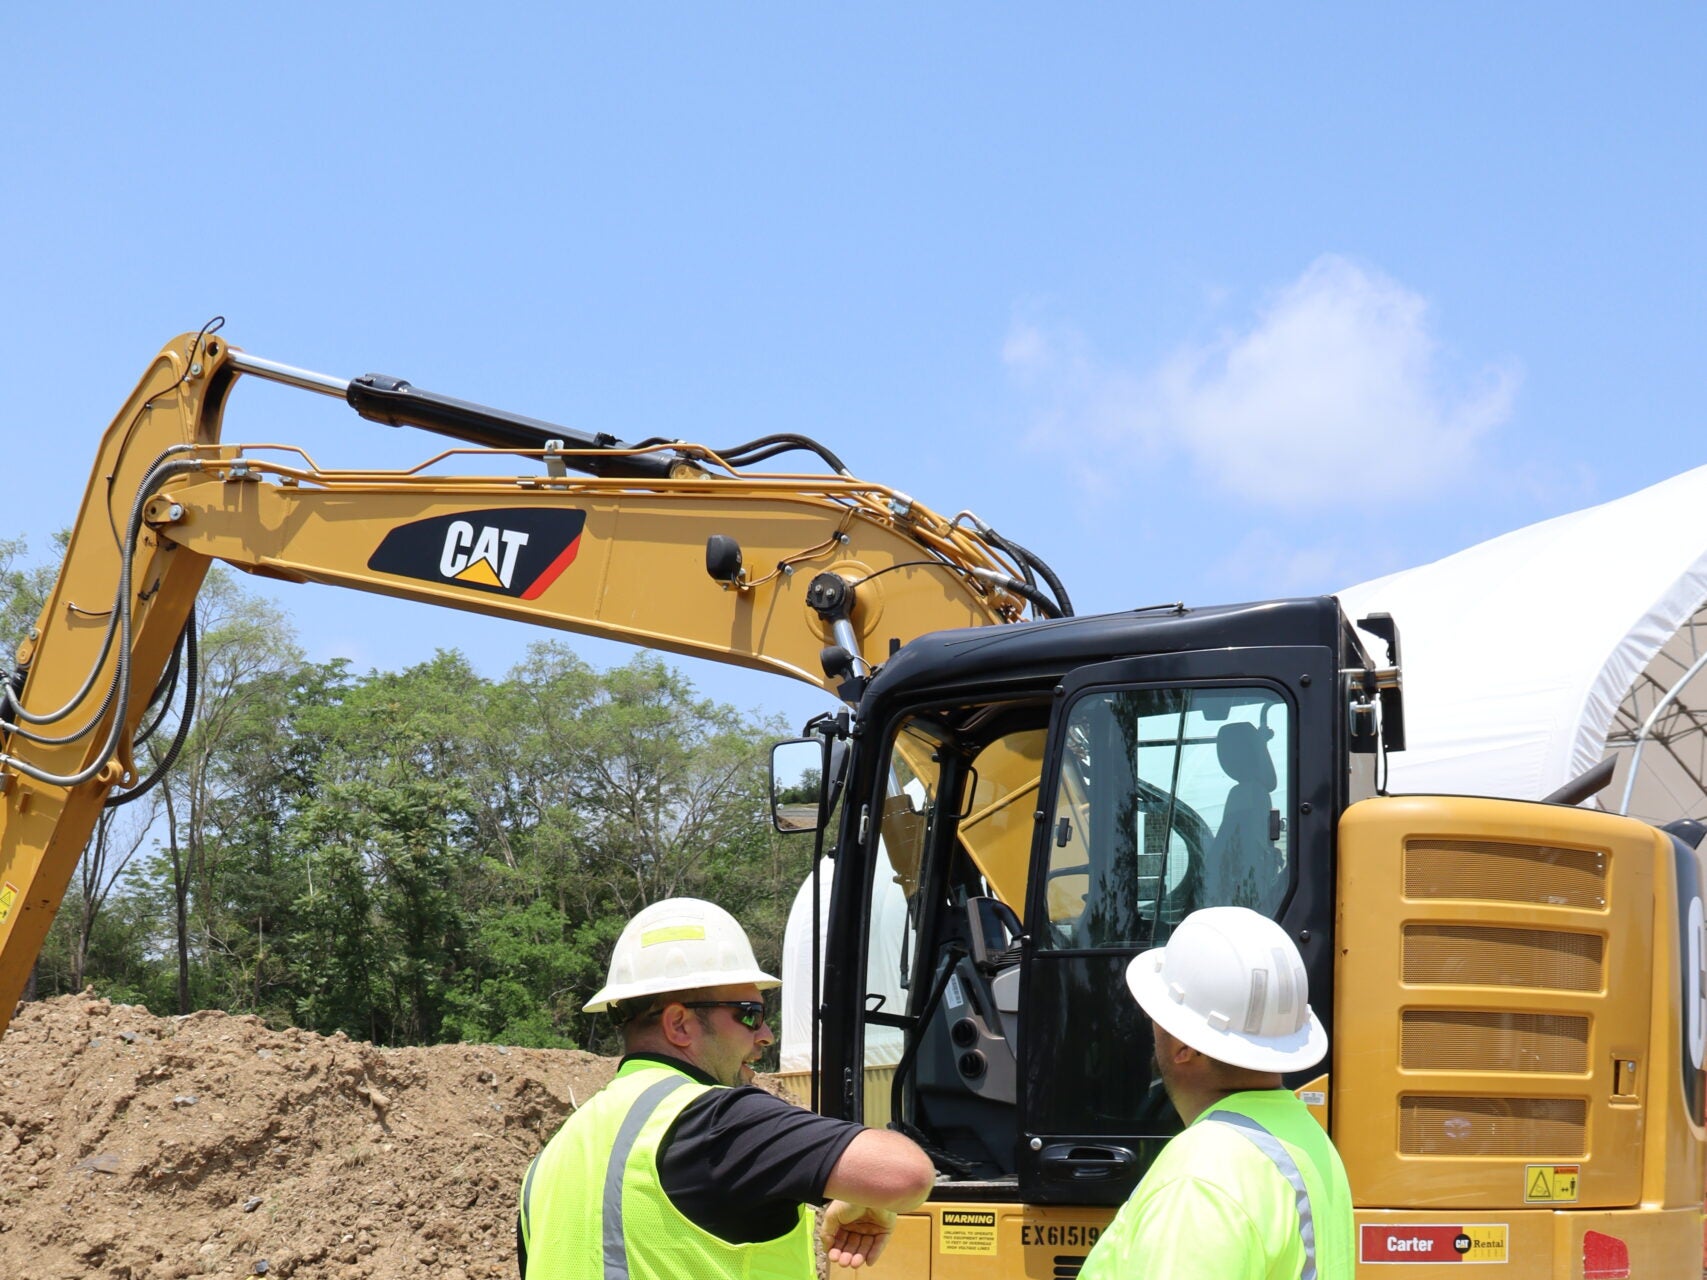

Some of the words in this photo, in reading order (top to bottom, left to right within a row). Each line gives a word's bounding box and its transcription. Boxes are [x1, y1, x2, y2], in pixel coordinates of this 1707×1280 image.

[439, 520, 529, 589] CAT
[944, 1214, 993, 1224] WARNING
[1021, 1225, 1108, 1246] EX61519
[1386, 1236, 1434, 1252] Carter
[1455, 1239, 1469, 1249] CAT
[1473, 1240, 1504, 1248] Rental
